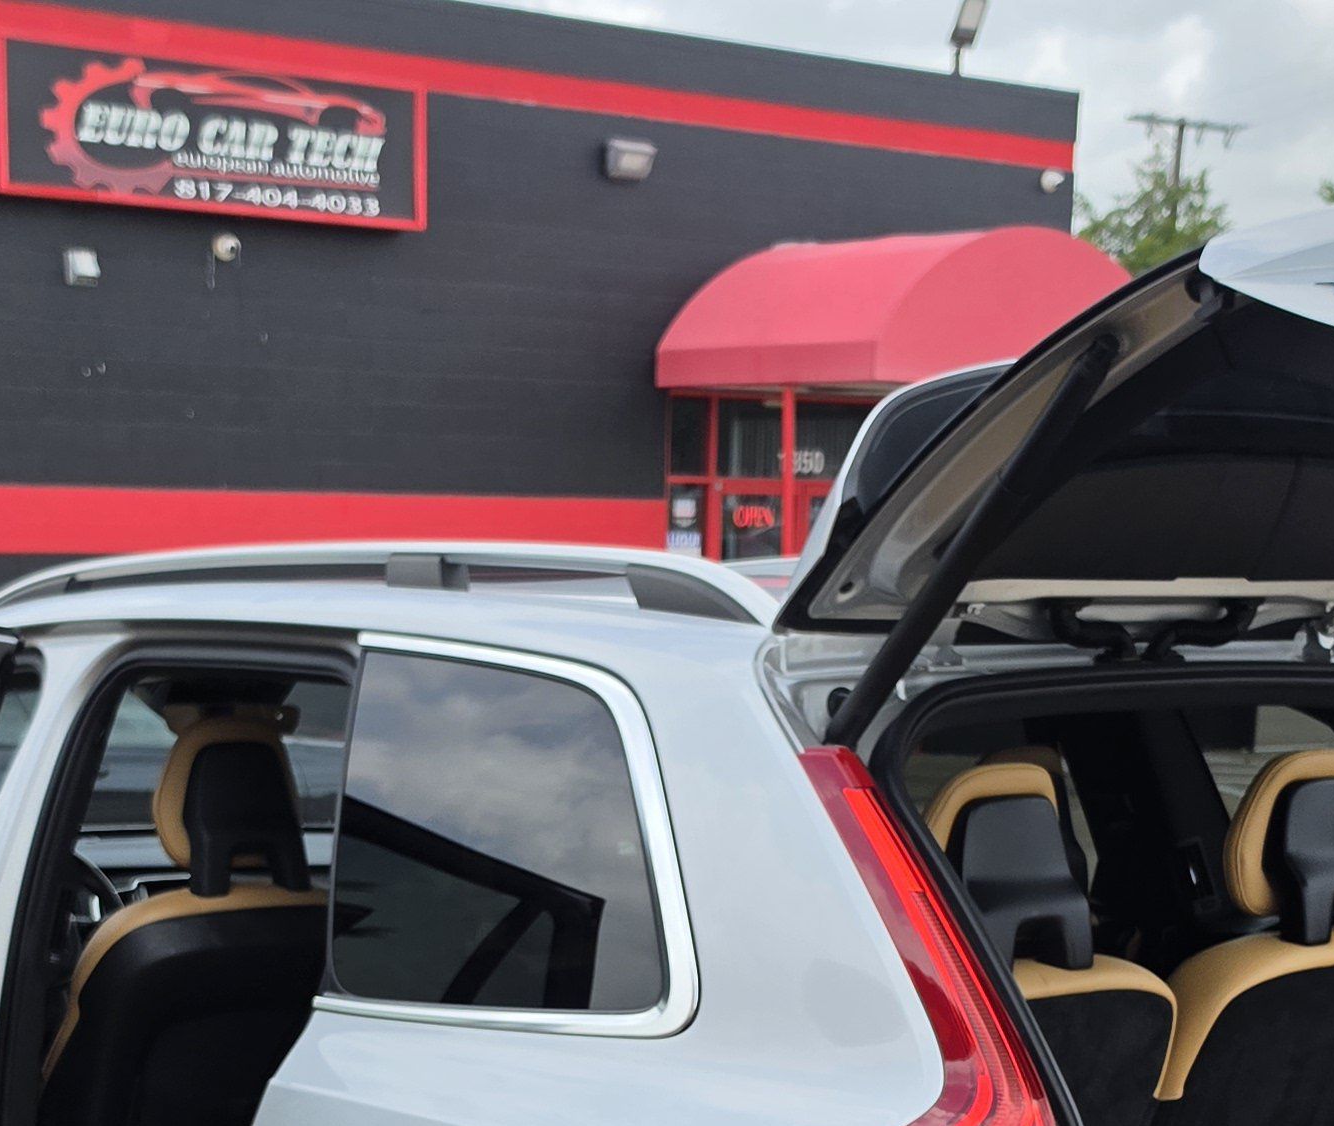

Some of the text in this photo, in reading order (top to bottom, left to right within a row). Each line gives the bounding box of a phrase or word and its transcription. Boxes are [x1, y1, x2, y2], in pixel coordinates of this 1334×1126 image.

[77, 101, 385, 173] EURO CAR TECH
[733, 504, 774, 528] OPEN
